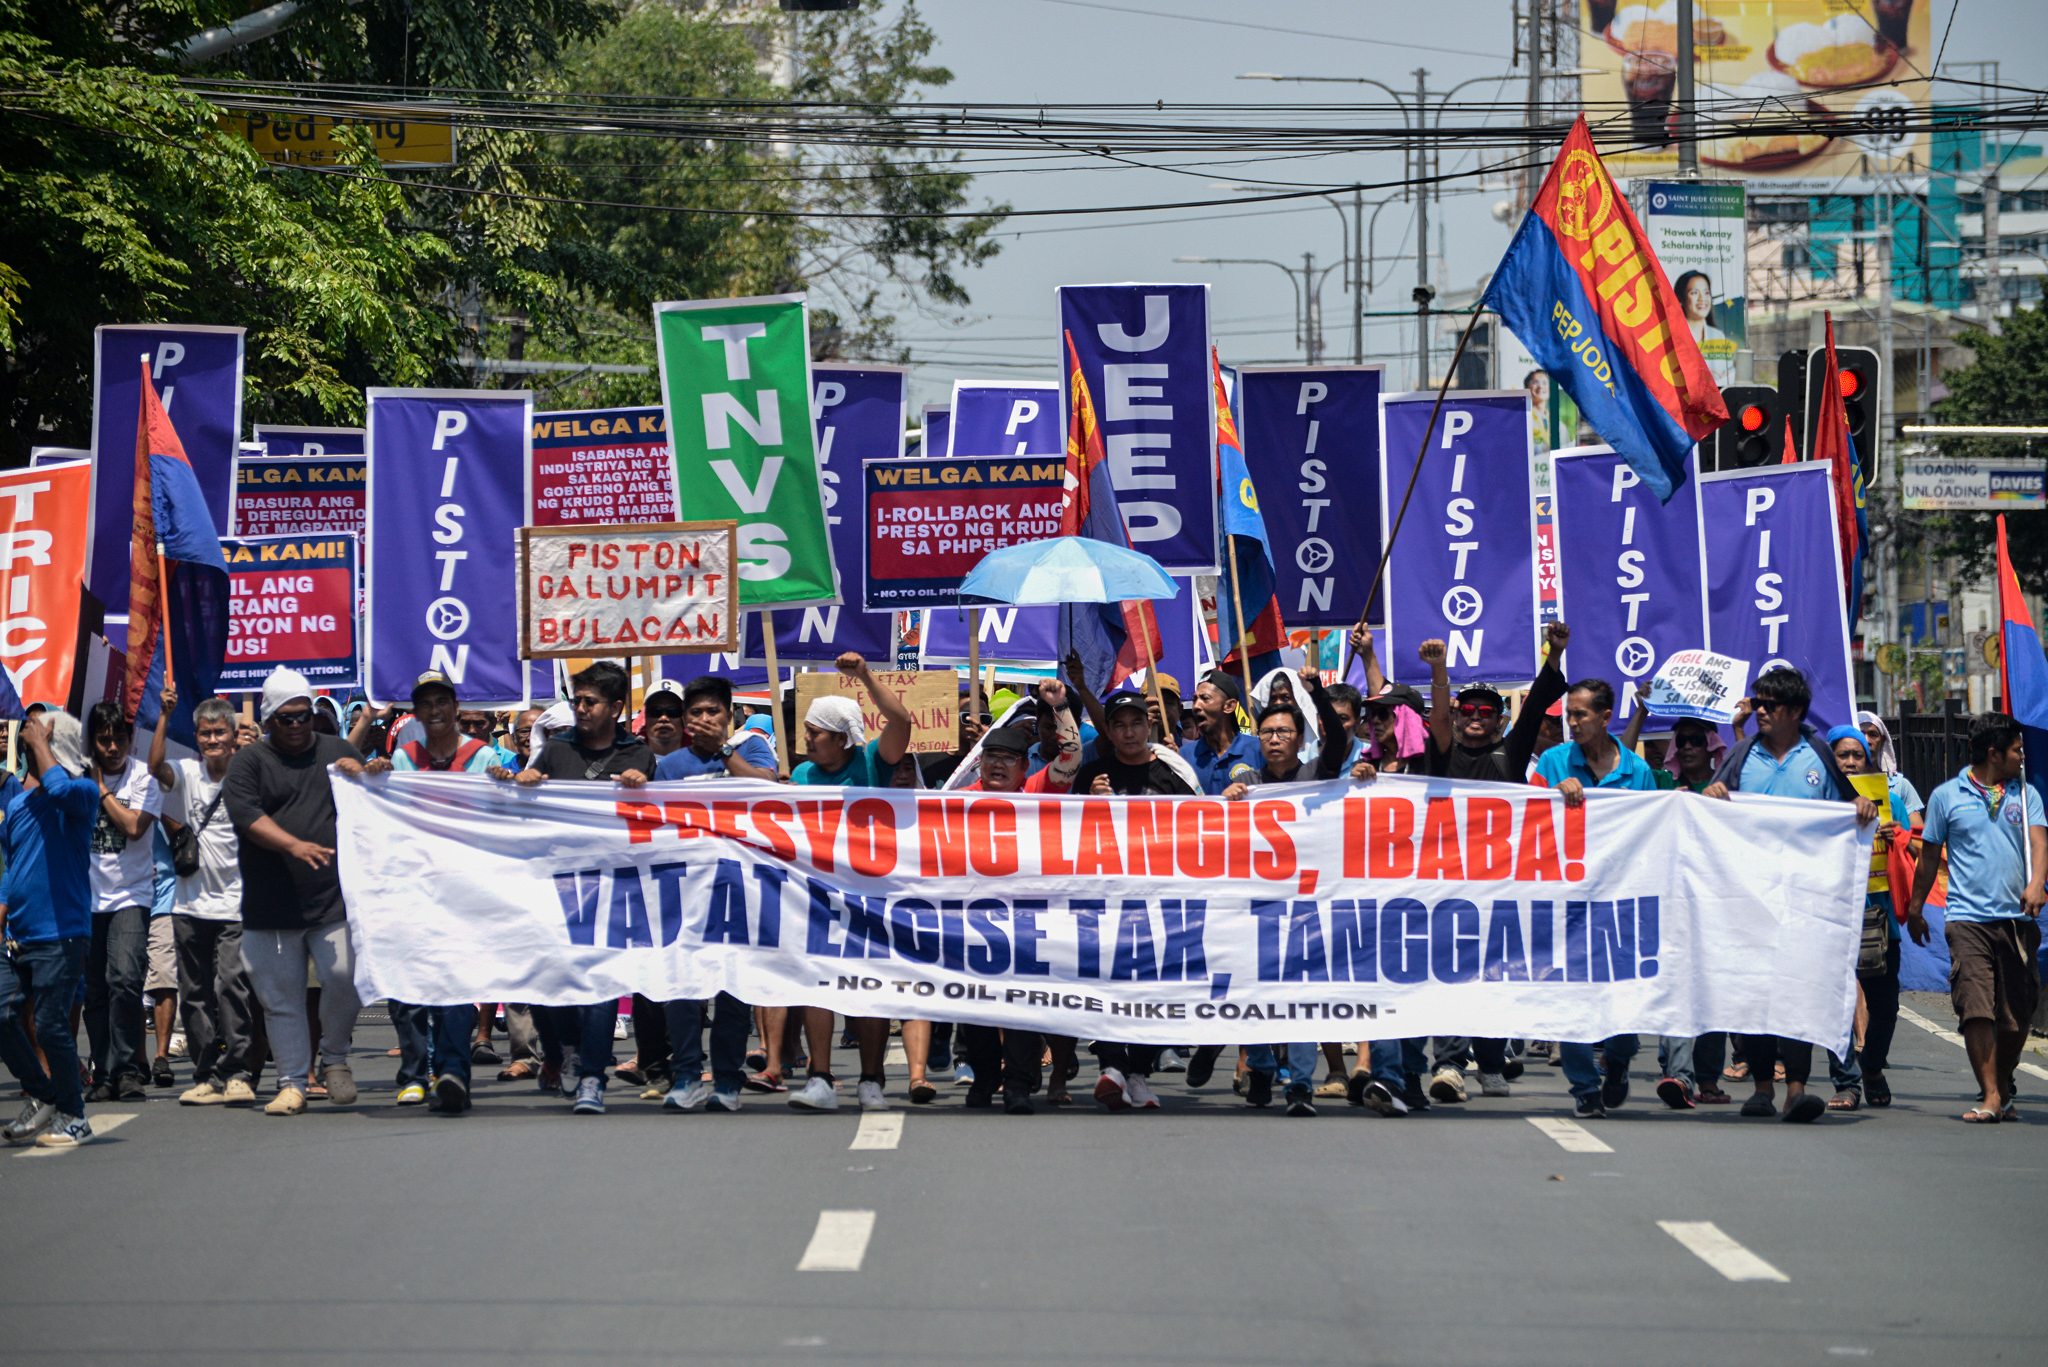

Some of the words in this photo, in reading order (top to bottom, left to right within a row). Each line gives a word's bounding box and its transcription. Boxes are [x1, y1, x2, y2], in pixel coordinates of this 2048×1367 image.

[247, 111, 315, 142] Ped
[310, 150, 324, 162] OF
[1709, 196, 1740, 204] COLLEGE
[1700, 229, 1732, 240] Kamay
[1661, 240, 1714, 252] Scholarship
[1715, 244, 1731, 252] ang
[1686, 255, 1719, 265] pag-asa
[1551, 300, 1583, 340] PEP
[532, 418, 633, 439] WELGA
[572, 447, 645, 461] ISABANSA
[649, 446, 669, 457] AN
[701, 322, 792, 582] TNVS
[539, 460, 627, 475] INDUSTRIYA
[632, 459, 652, 469] NG
[1915, 464, 1978, 476] LOADING
[237, 468, 302, 484] ELGA
[308, 467, 366, 482] KAM
[568, 474, 587, 485] SA
[592, 470, 651, 483] KAGYAT,
[874, 467, 983, 486] WELGA
[989, 464, 1064, 482] KAMI
[543, 482, 624, 497] GOBYERNO
[628, 481, 659, 492] ANG
[1990, 476, 2042, 490] DAVIES
[1296, 381, 1335, 612] PISTON
[1905, 485, 1987, 498] UNLOADING
[238, 497, 313, 509] IBASURA
[318, 496, 355, 508] ANG
[537, 498, 558, 509] NG
[562, 496, 613, 508] KRUDO
[618, 494, 637, 505] AT
[641, 492, 673, 503] IBEN
[247, 508, 366, 521] DEREGULATIO
[560, 509, 579, 519] SA
[583, 507, 614, 517] MAS
[618, 504, 675, 516] MABABA
[877, 504, 1011, 523] I-ROLLBACK
[1018, 503, 1063, 519] ANG
[248, 523, 269, 535] AT
[274, 521, 366, 534] MAGPATUP
[877, 523, 958, 539] PRESYO
[965, 523, 994, 536] NG
[1001, 521, 1060, 535] KRUD
[1441, 410, 1484, 668] PISTON
[260, 541, 345, 562] KAMI!
[425, 410, 470, 684] PISTON
[901, 540, 931, 555] SA
[260, 576, 314, 595] ANG
[880, 589, 897, 598] NO
[898, 589, 916, 598] TO
[917, 588, 937, 597] OIL
[938, 588, 960, 596] PRI
[229, 597, 299, 616] RANG
[229, 617, 292, 636] SYON
[300, 615, 336, 633] NG
[538, 613, 719, 645] BULACAN
[904, 662, 917, 671] US
[1705, 656, 1732, 670] ANG
[220, 670, 247, 679] RICE
[660, 680, 672, 691] C
[1664, 692, 1680, 704] SA
[909, 741, 950, 752] PISTON
[615, 798, 898, 878] PRESYO
[918, 798, 1019, 878] NG
[1039, 799, 1319, 895] LANGIS,
[1343, 796, 1587, 882] IBABA!
[552, 861, 688, 948] VAT
[702, 857, 789, 948] AT
[806, 876, 1051, 976] EXCISE
[1068, 899, 1232, 1001] TAX,
[1250, 895, 1660, 985] TANGGALIN!
[837, 976, 883, 992] NO
[891, 981, 935, 997] TO
[942, 983, 986, 1001] OIL
[1005, 989, 1102, 1014] PRICE
[1110, 1001, 1186, 1020] HIKE
[1206, 1002, 1378, 1020] COALITION
